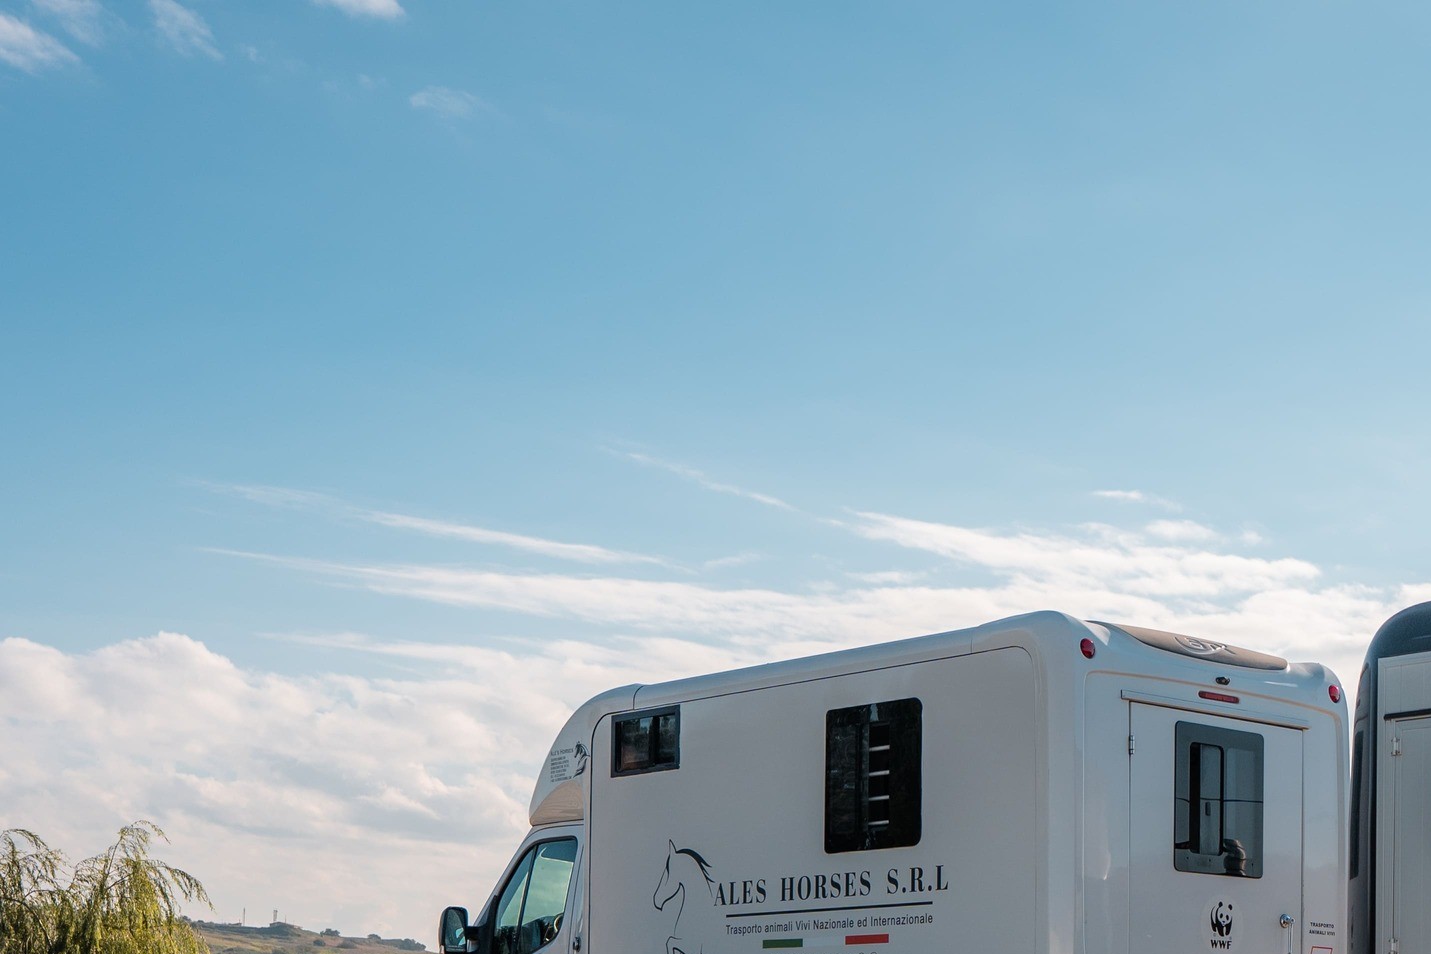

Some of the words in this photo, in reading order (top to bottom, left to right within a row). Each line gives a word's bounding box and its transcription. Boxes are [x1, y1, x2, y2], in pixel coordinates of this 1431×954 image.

[713, 878, 767, 907] ALES
[780, 870, 872, 902] HORSES
[886, 864, 949, 895] S.R.L
[726, 924, 762, 937] Trasporto
[764, 922, 793, 933] animali
[795, 920, 811, 931] Vivi
[813, 918, 854, 930] Nazionale
[857, 917, 868, 928] ed
[870, 913, 933, 927] Internazionale
[1310, 921, 1335, 929] TRASPORTO
[1210, 939, 1233, 950] WWF
